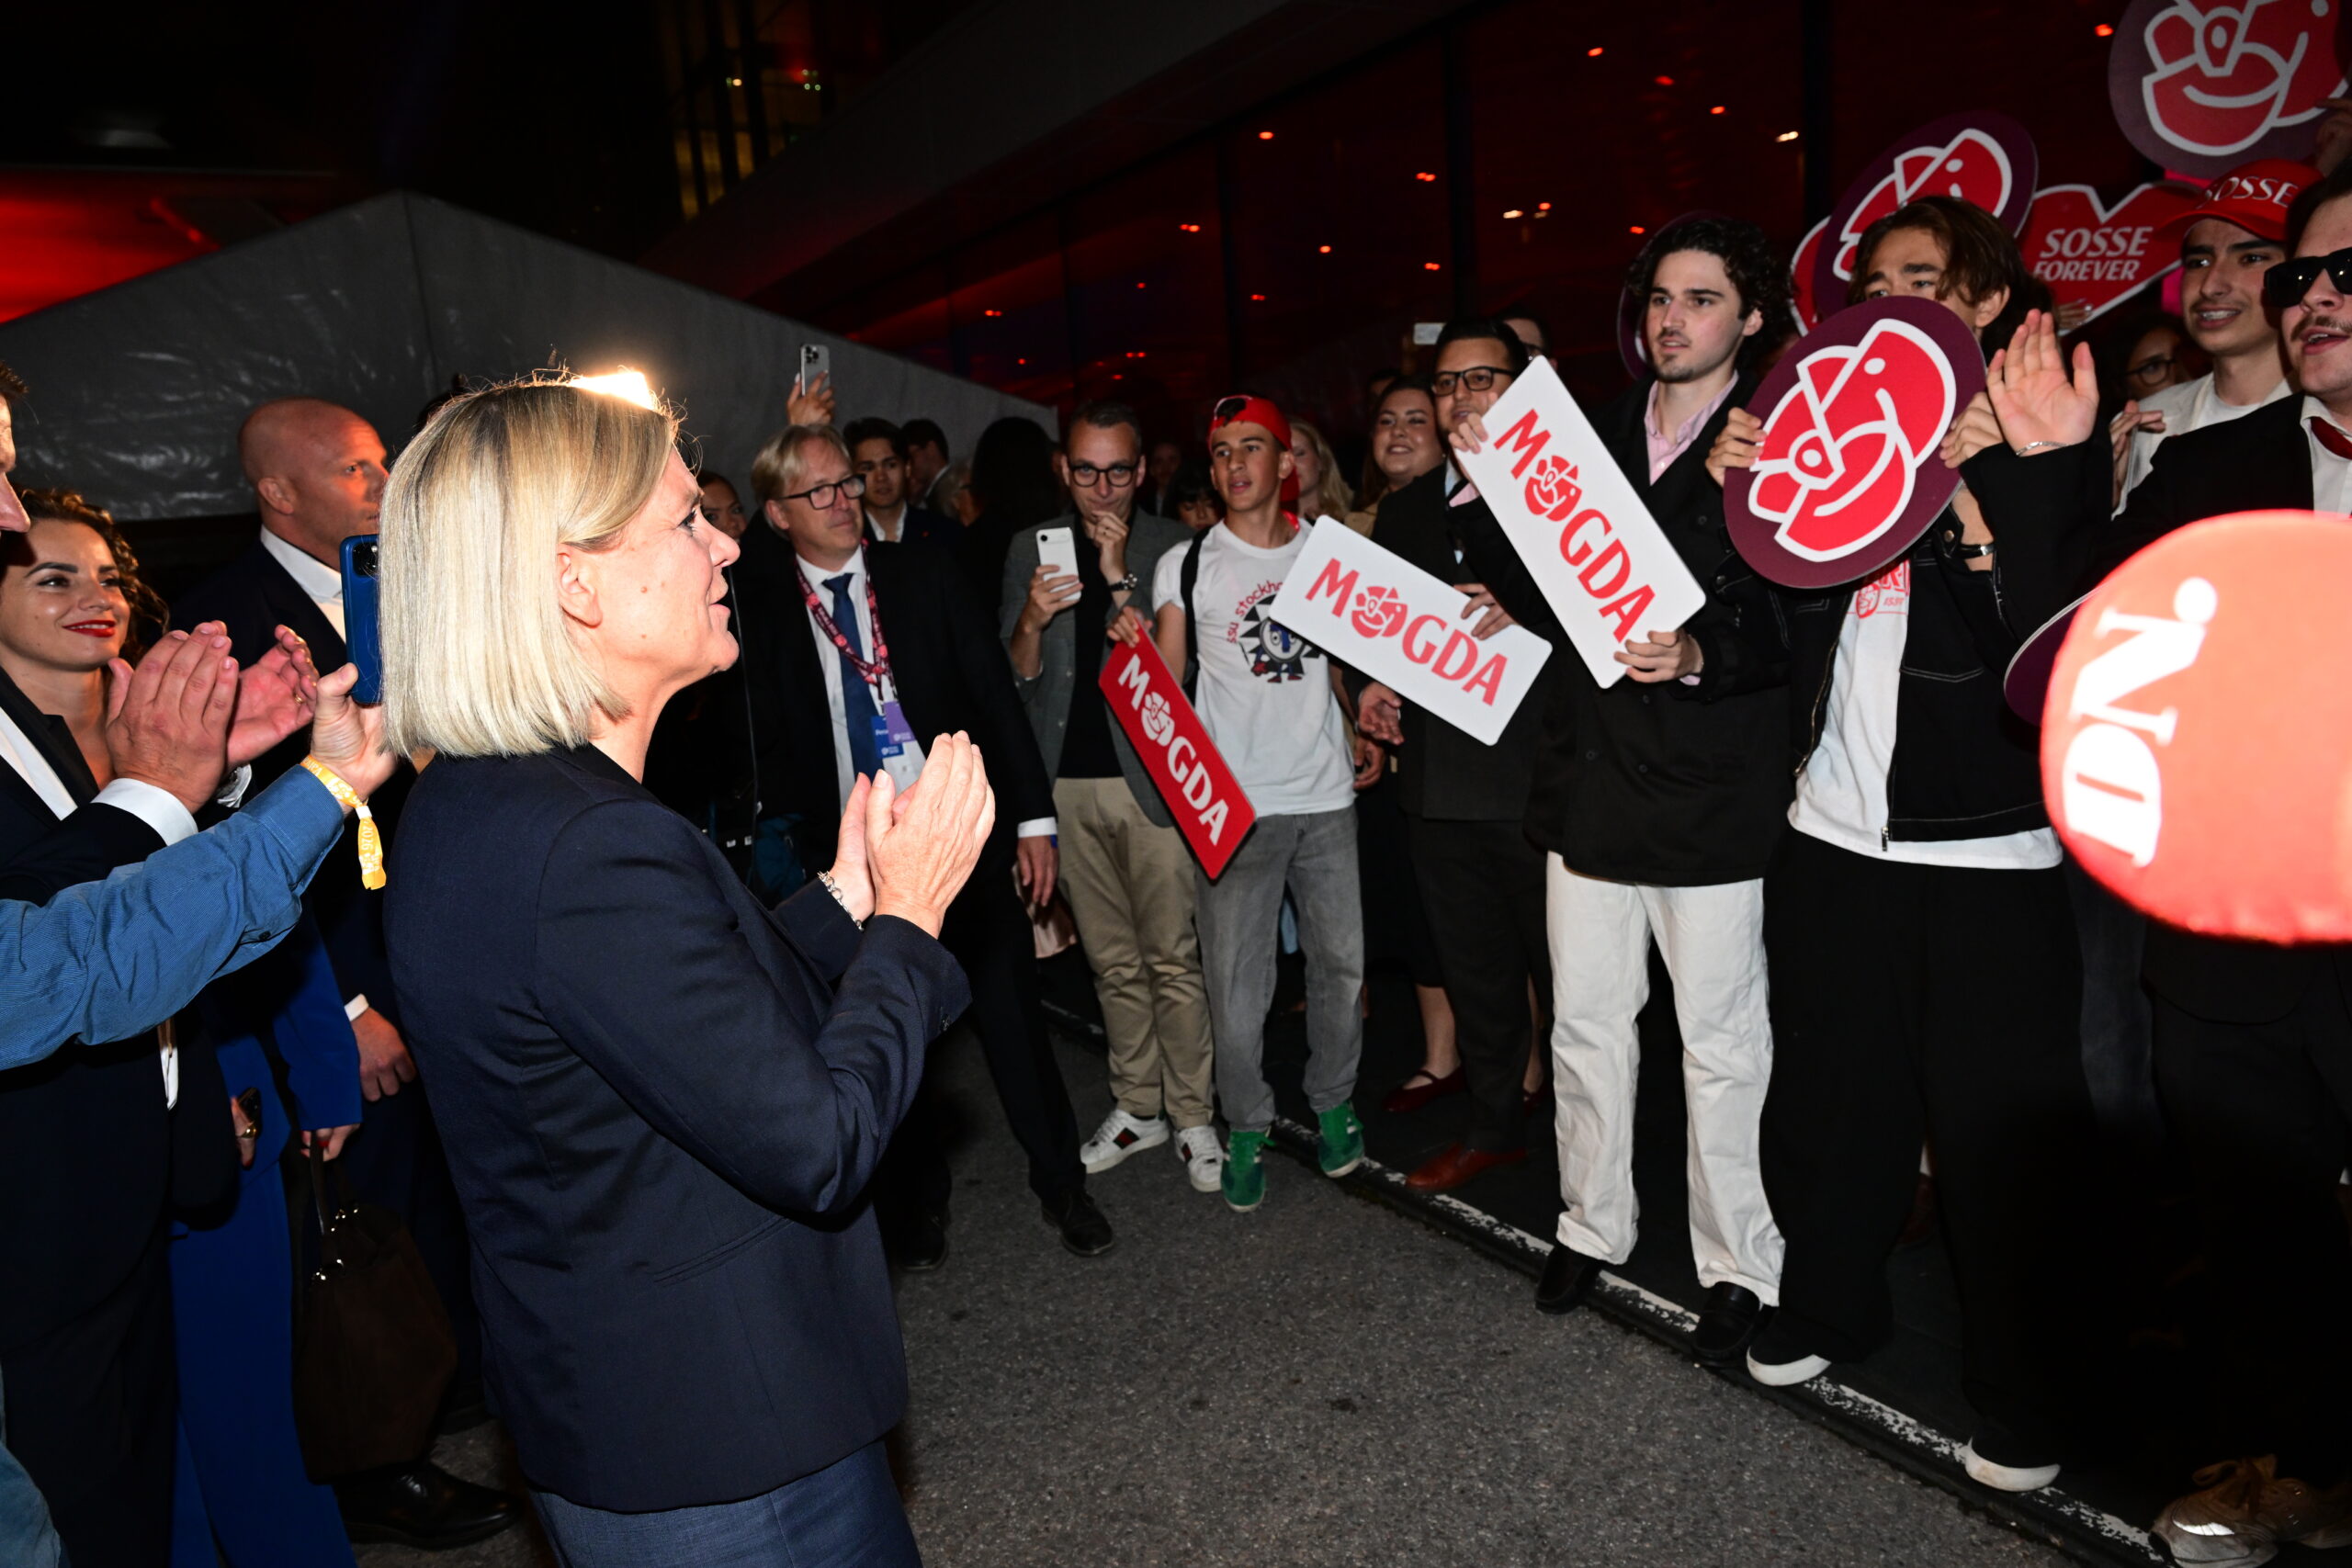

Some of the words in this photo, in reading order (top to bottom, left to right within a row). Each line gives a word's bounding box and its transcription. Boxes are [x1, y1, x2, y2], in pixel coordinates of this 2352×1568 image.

[2040, 227, 2154, 258] SOSSE
[2033, 258, 2140, 282] FOREVER
[2062, 576, 2217, 868] DN.
